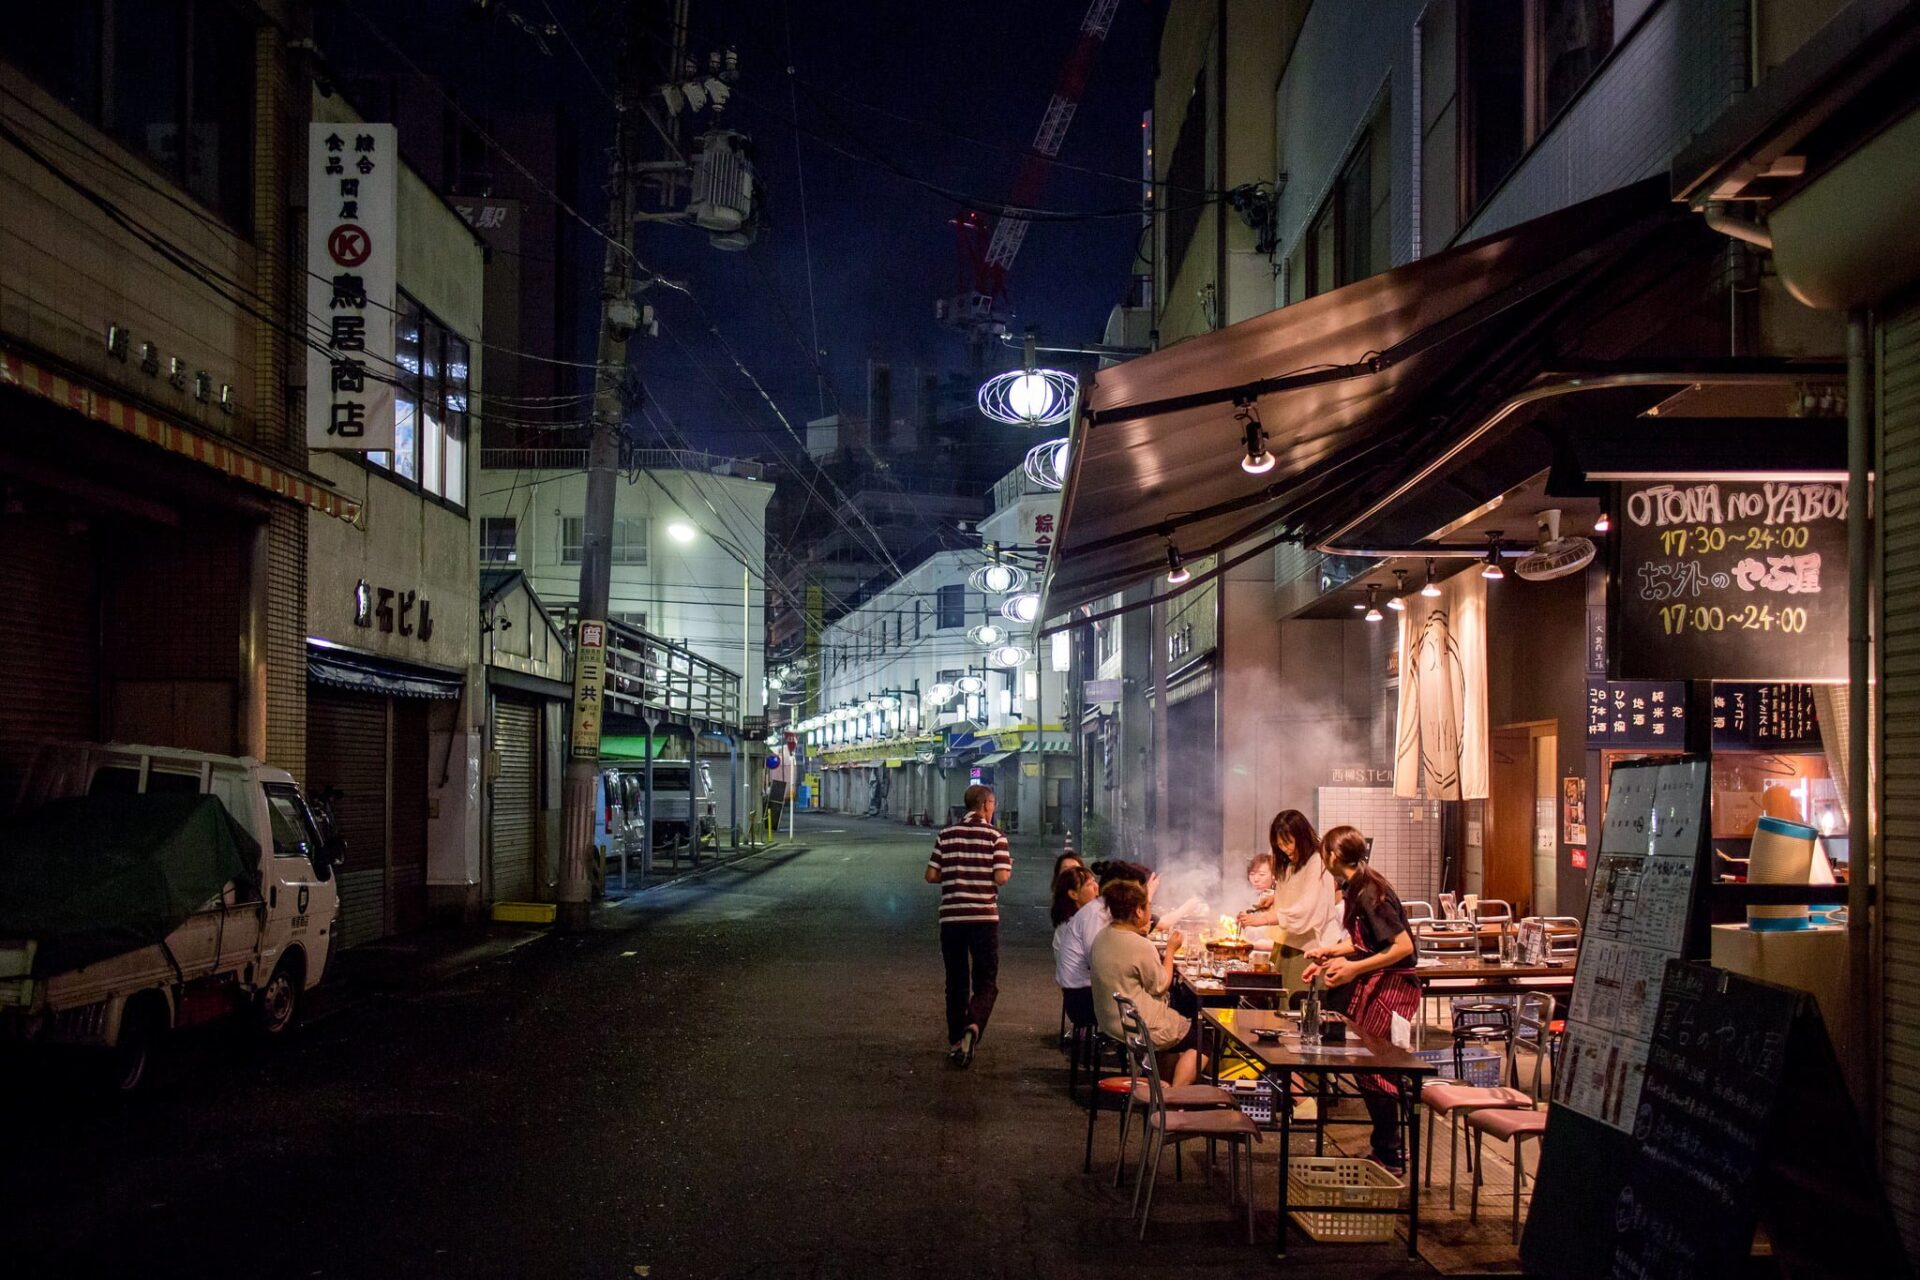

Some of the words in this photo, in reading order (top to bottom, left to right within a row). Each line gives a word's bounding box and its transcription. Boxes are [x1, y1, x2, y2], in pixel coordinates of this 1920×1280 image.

[325, 132, 344, 175] 食品
[326, 272, 367, 438] 鳥居商店
[1627, 484, 1724, 527] OTONA
[581, 665, 598, 702] 三共
[1597, 690, 1607, 732] 日本酒
[1632, 697, 1645, 726] 地酒
[1651, 691, 1665, 734] 純米酒
[1733, 693, 1745, 731] マッコリ
[1758, 687, 1769, 737] チャミスル
